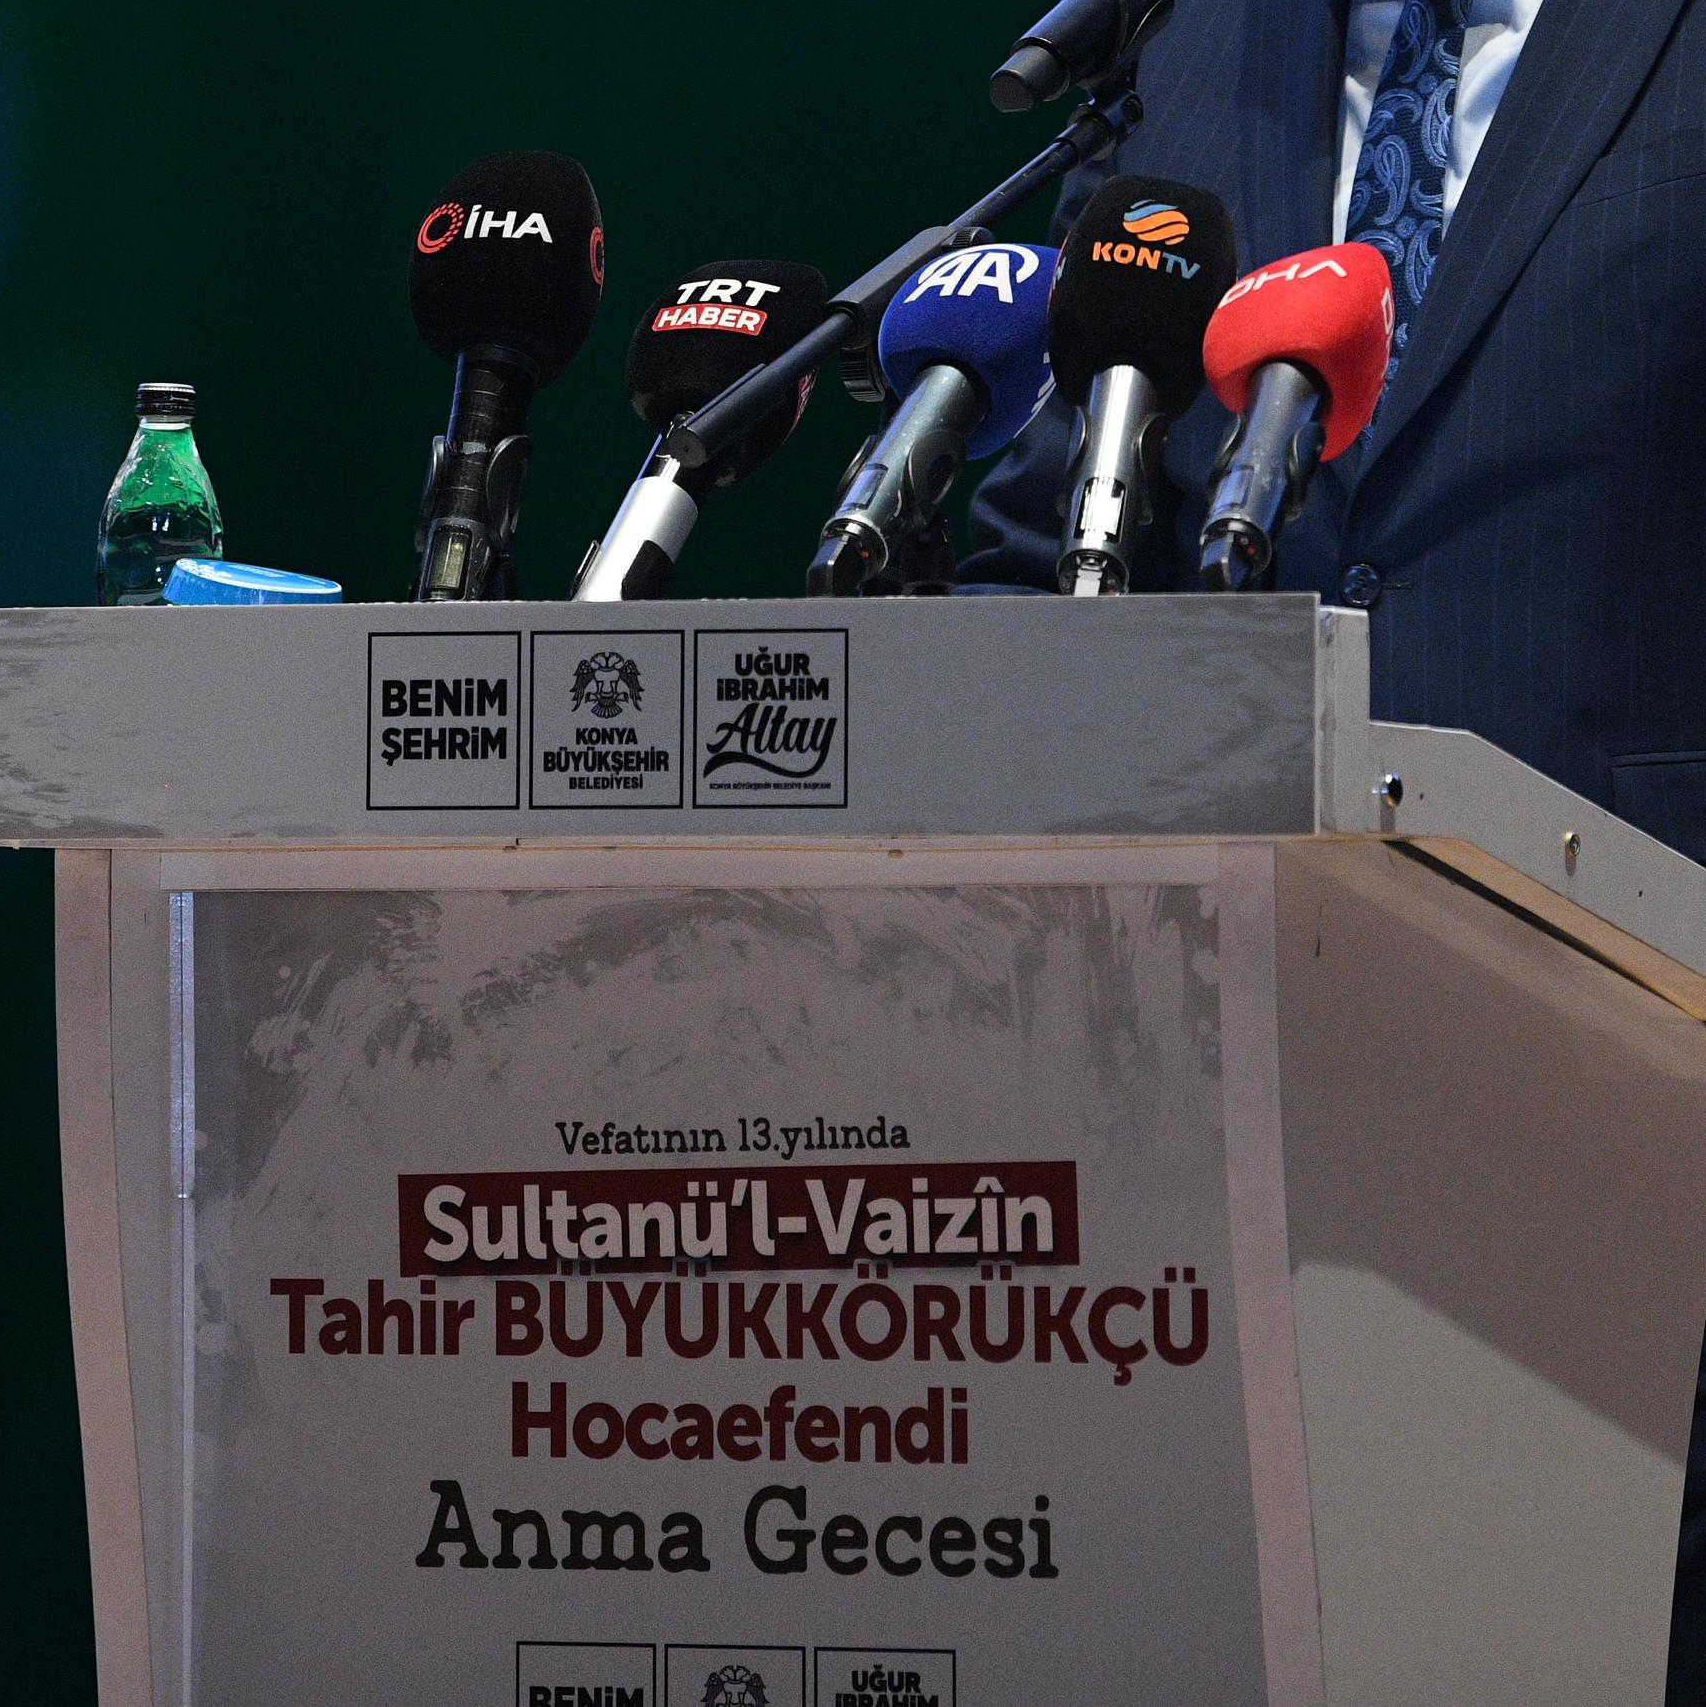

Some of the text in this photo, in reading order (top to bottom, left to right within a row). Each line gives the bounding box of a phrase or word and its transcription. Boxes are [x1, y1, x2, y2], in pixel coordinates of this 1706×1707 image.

[464, 204, 553, 243] İHA
[904, 248, 1025, 304] AA
[677, 278, 781, 307] TRT
[658, 307, 761, 331] HABER
[735, 646, 810, 676] UĞUR
[575, 727, 638, 745] KONYA
[703, 702, 837, 778] Altay
[543, 746, 669, 775] BÜYÜKŞEHİR
[569, 774, 643, 789] BELEDİYESİ
[555, 1121, 727, 1155] Vefatının
[271, 1261, 1209, 1386] Tahir BÜYÜKKÖRÜKÇÜ
[512, 1382, 968, 1464] Hocaefendi
[415, 1480, 1060, 1579] Anma Gecesi
[852, 1664, 921, 1693] UĞUR
